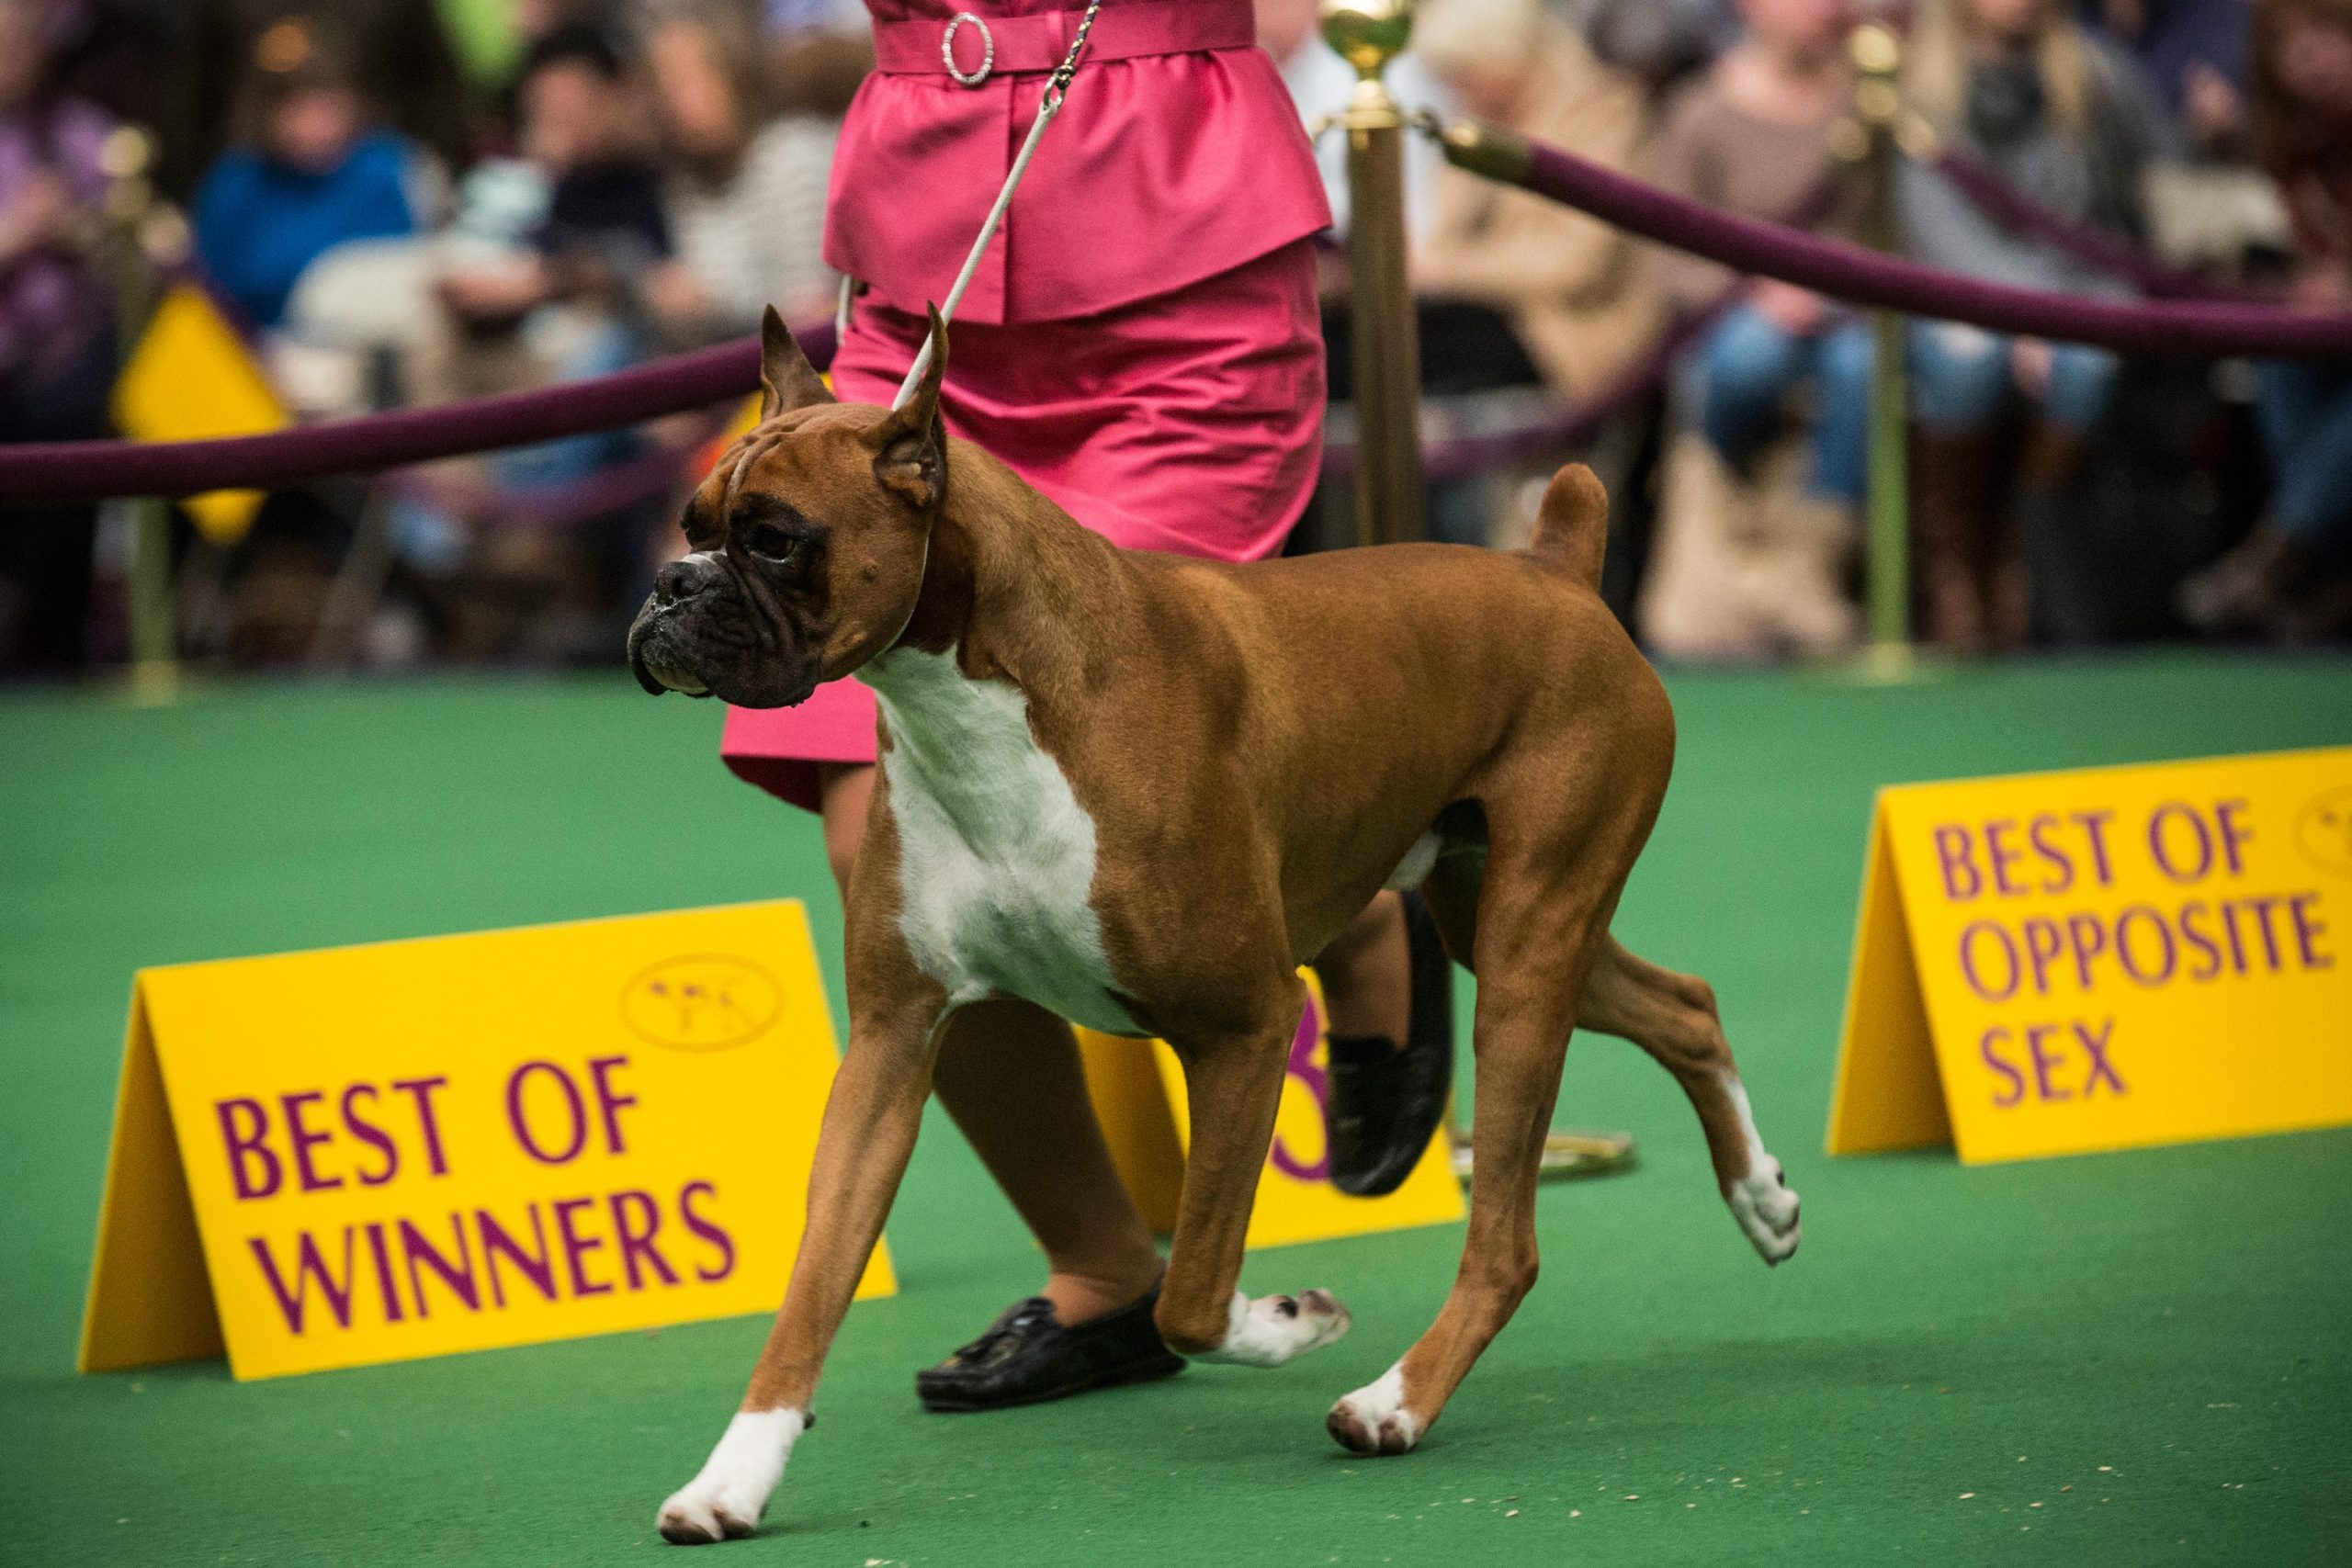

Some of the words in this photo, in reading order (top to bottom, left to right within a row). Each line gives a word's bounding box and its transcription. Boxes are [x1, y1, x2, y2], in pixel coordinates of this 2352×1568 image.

[1933, 809, 2115, 901] BEST
[2146, 799, 2254, 886] OF
[1958, 892, 2335, 1002] OPPOSITE
[1979, 1019, 2127, 1108] SEX
[215, 1076, 449, 1201] BEST
[505, 1055, 639, 1165] OF
[246, 1179, 736, 1337] WINNERS
